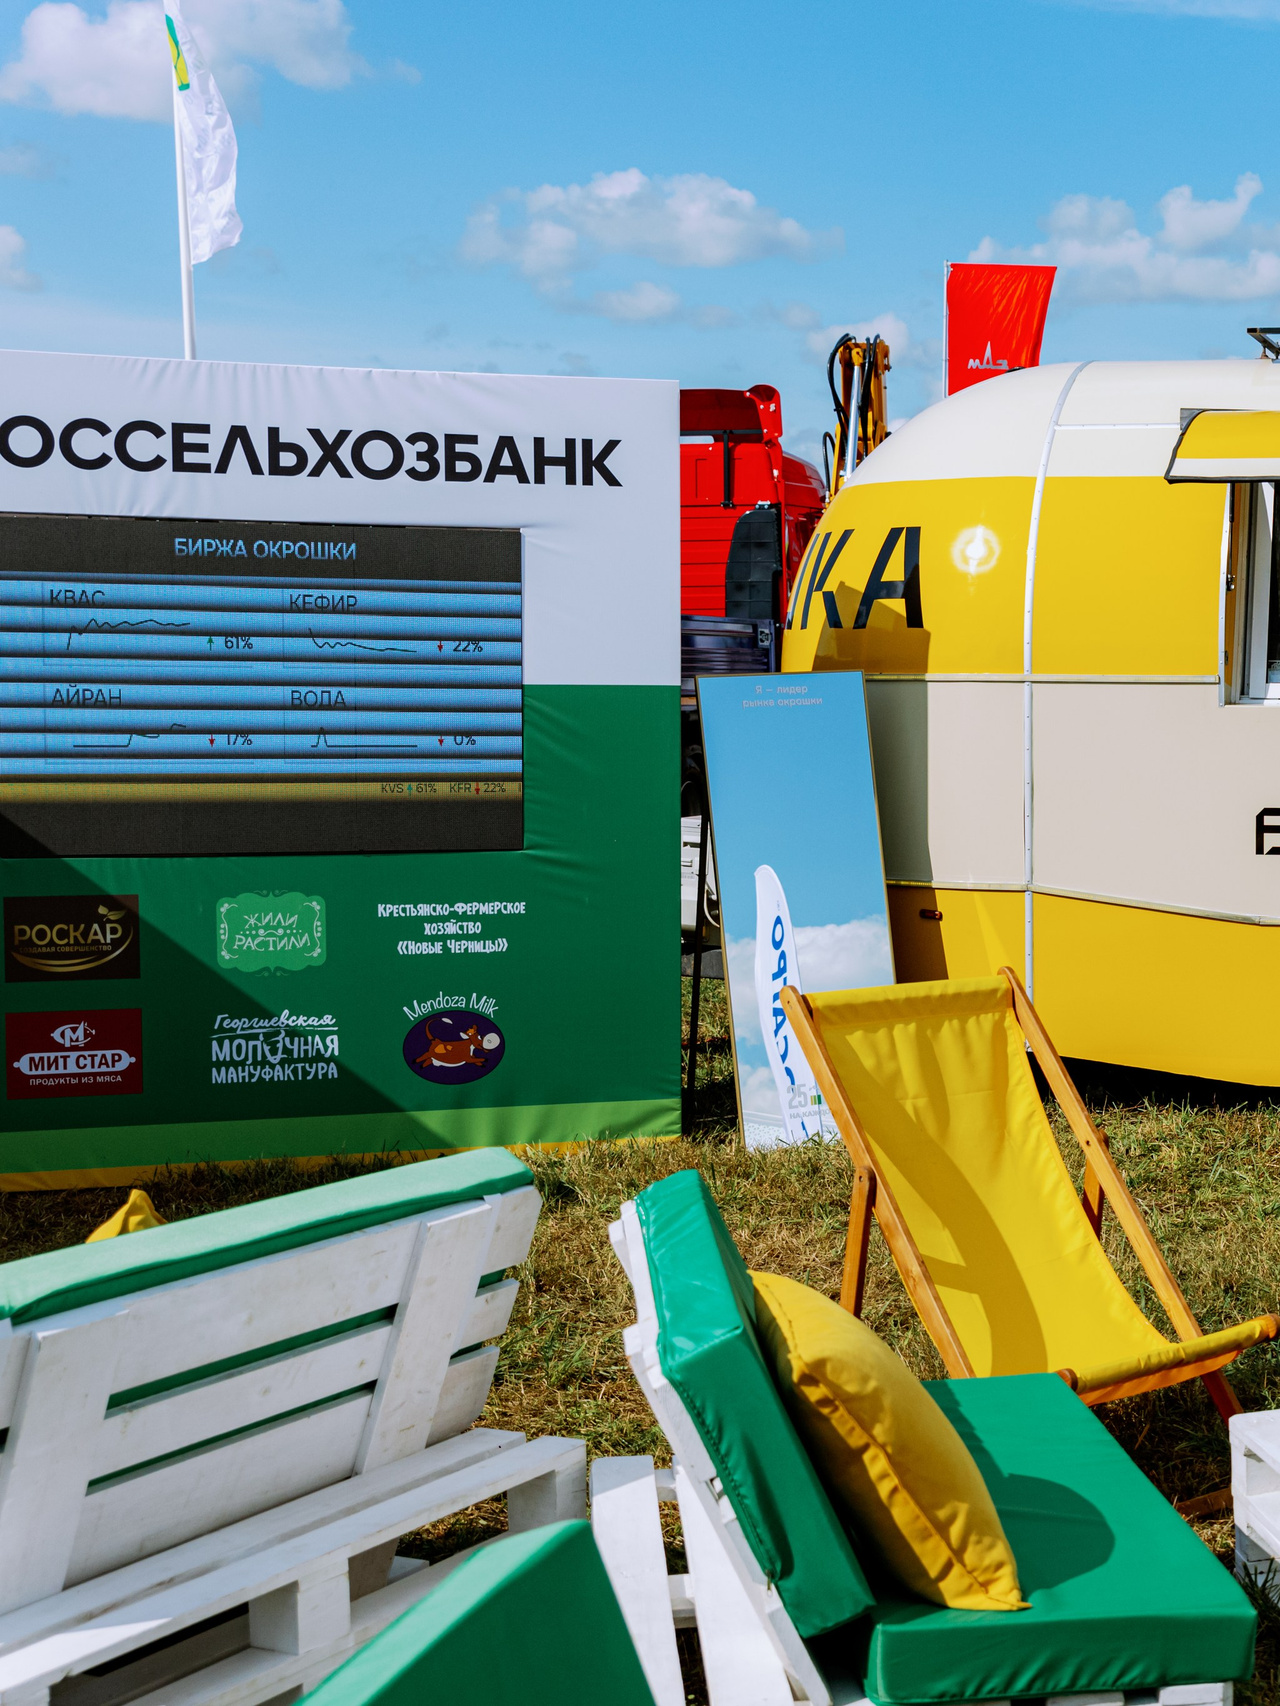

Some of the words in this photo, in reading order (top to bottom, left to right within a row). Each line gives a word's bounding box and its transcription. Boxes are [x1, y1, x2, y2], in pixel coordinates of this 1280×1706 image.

[0, 415, 623, 487] ОССЕЛЬХОЗБАНК
[174, 538, 248, 559] БИРЖА
[253, 539, 357, 560] ОКРОШКИ
[50, 589, 105, 606] КВАС
[289, 594, 358, 612] КЕФИР
[224, 636, 254, 650] 61%
[453, 641, 483, 653] 22%
[51, 684, 122, 706] АЙРАН
[290, 690, 347, 708] ВОДА
[776, 686, 808, 695] лидер
[742, 699, 774, 710] рынка
[777, 697, 823, 709] окрошки
[381, 783, 404, 793] KVS
[416, 783, 437, 793] 61%
[449, 782, 472, 793] KFR
[483, 782, 507, 793] 22%
[243, 911, 299, 929] ЖИЛИ
[424, 919, 482, 935] ХОЗЯЙСТВО
[14, 923, 122, 946] РОСКАР
[232, 933, 311, 951] РАСТИЛИ
[57, 945, 112, 953] СОВЕРШЕНСТВО
[402, 991, 466, 1021] Mendoza
[470, 993, 499, 1018] Milk
[214, 1009, 336, 1033] Георгиевская
[29, 1055, 70, 1072] МИТ
[75, 1053, 123, 1070] СТАР
[29, 1077, 78, 1086] ПРОДУКТЫ
[96, 1075, 122, 1083] МЯСА
[211, 1062, 339, 1084] МАНУФАКТУРА
[786, 1084, 808, 1110] 25
[802, 1109, 830, 1118] КАЖДО
